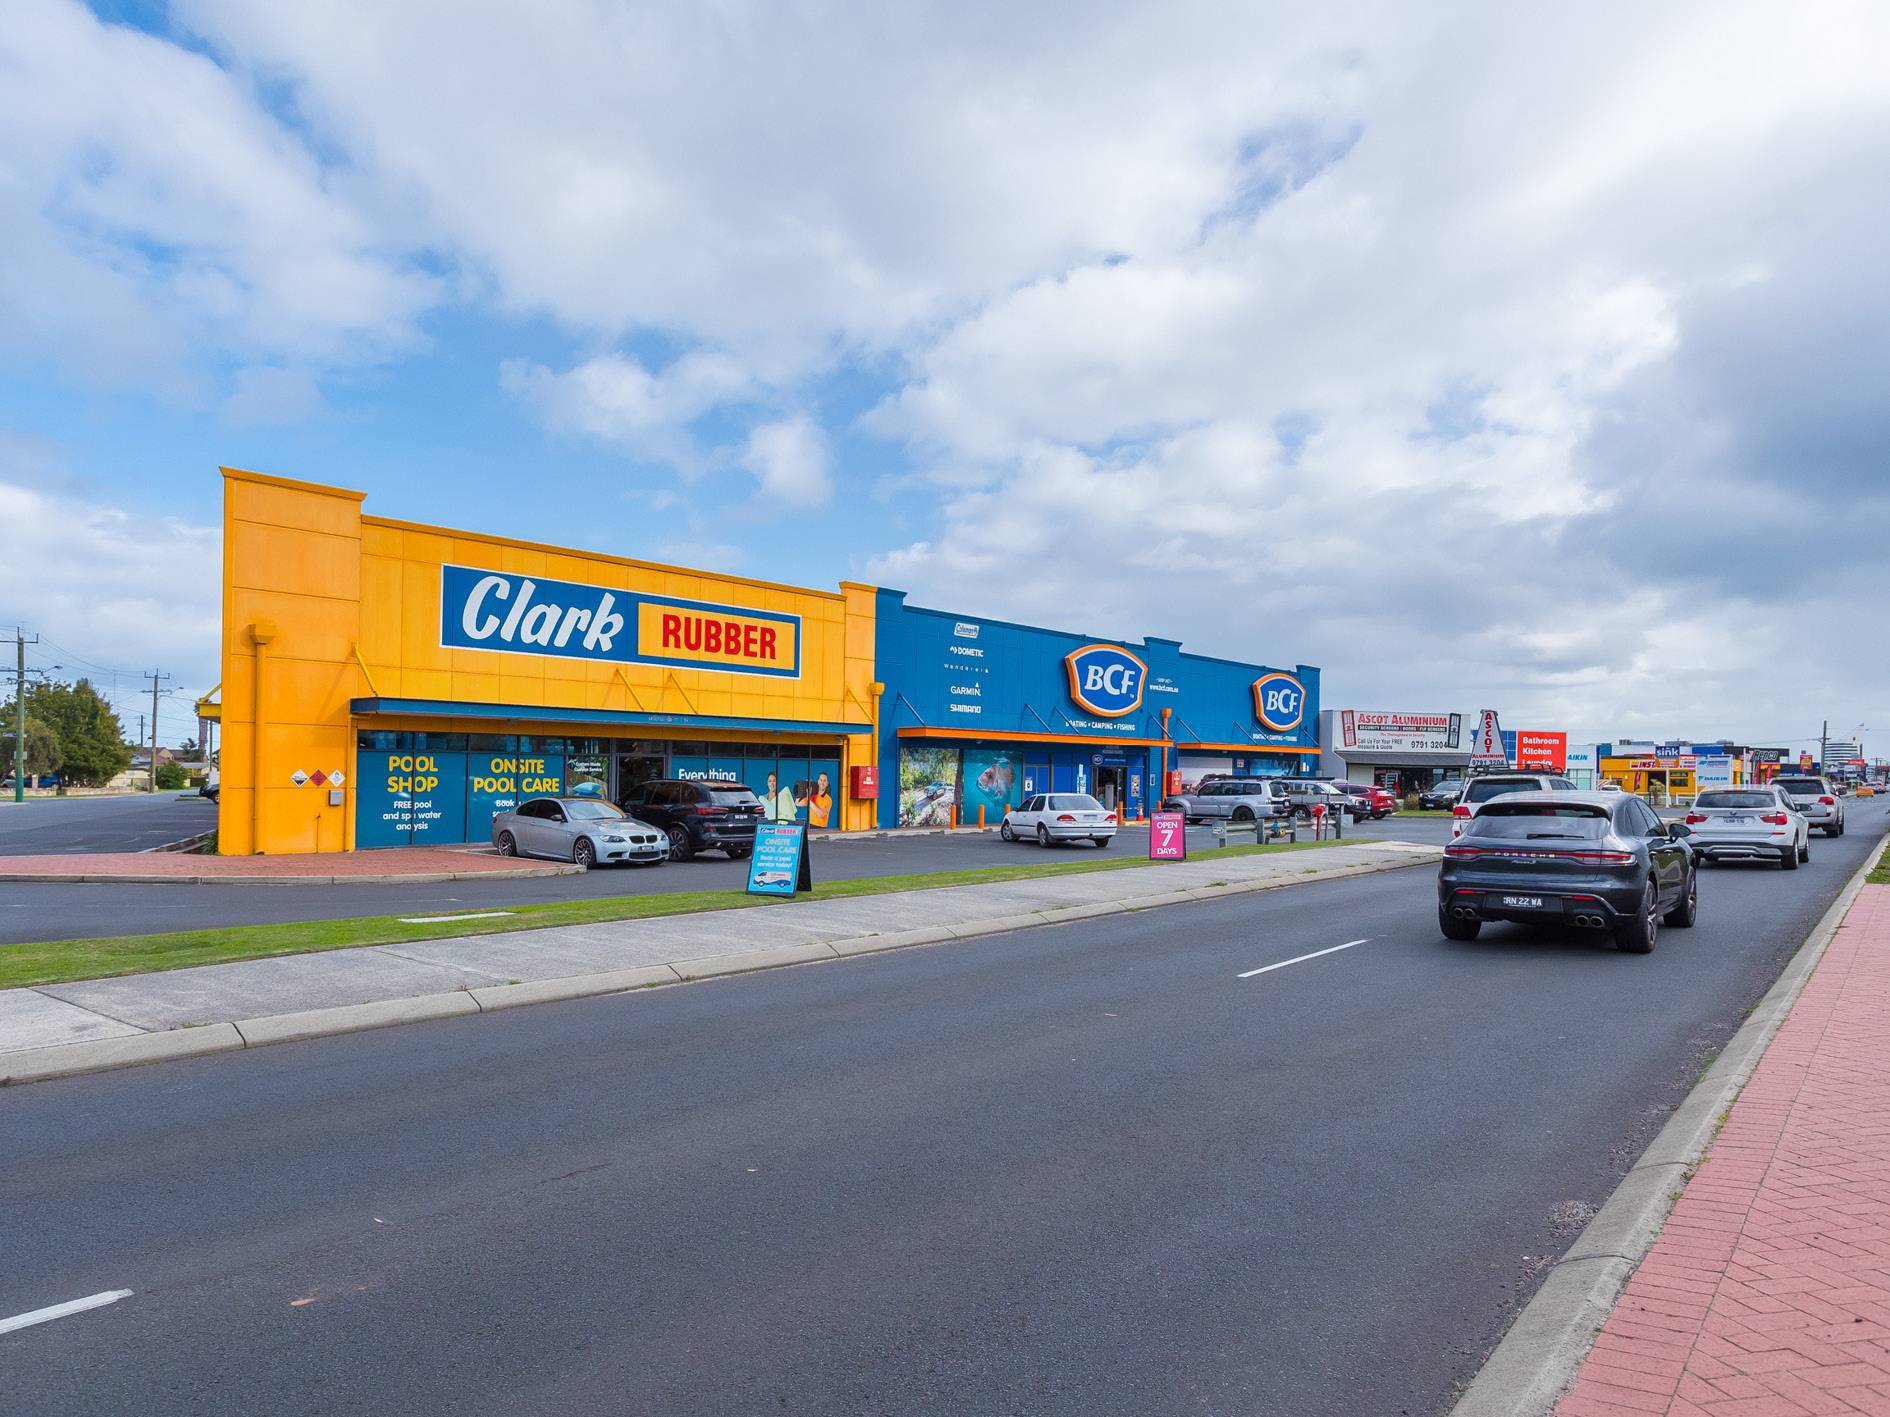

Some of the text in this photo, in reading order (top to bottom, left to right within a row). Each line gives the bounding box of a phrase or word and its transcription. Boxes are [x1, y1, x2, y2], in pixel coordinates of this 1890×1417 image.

[462, 575, 777, 660] Clark RUBBER
[957, 647, 984, 658] DOMETIC
[1084, 664, 1136, 695] BCF
[950, 685, 981, 696] GARMIN
[1266, 688, 1299, 713] BCF
[950, 703, 982, 714] SHIMANO
[1358, 713, 1447, 726] ASCOT ALUMINIUM
[1411, 740, 1448, 749] 9791 3204
[1522, 736, 1559, 744] Bathroom
[1522, 747, 1552, 755] Kitchen
[1656, 747, 1679, 757] sink
[388, 755, 439, 772] POOL
[490, 757, 545, 774] ONSITE
[678, 768, 737, 782] Everything
[387, 776, 439, 793] SHOP
[473, 777, 560, 793] POOL CARE
[393, 800, 432, 810] FREE pool
[496, 799, 515, 807] Book
[382, 811, 399, 820] and
[418, 811, 442, 819] water
[395, 821, 429, 832] anaysis
[1156, 821, 1178, 829] OPEN
[1160, 829, 1174, 847] 7
[1157, 847, 1177, 855] DAYS
[1518, 897, 1529, 906] 22
